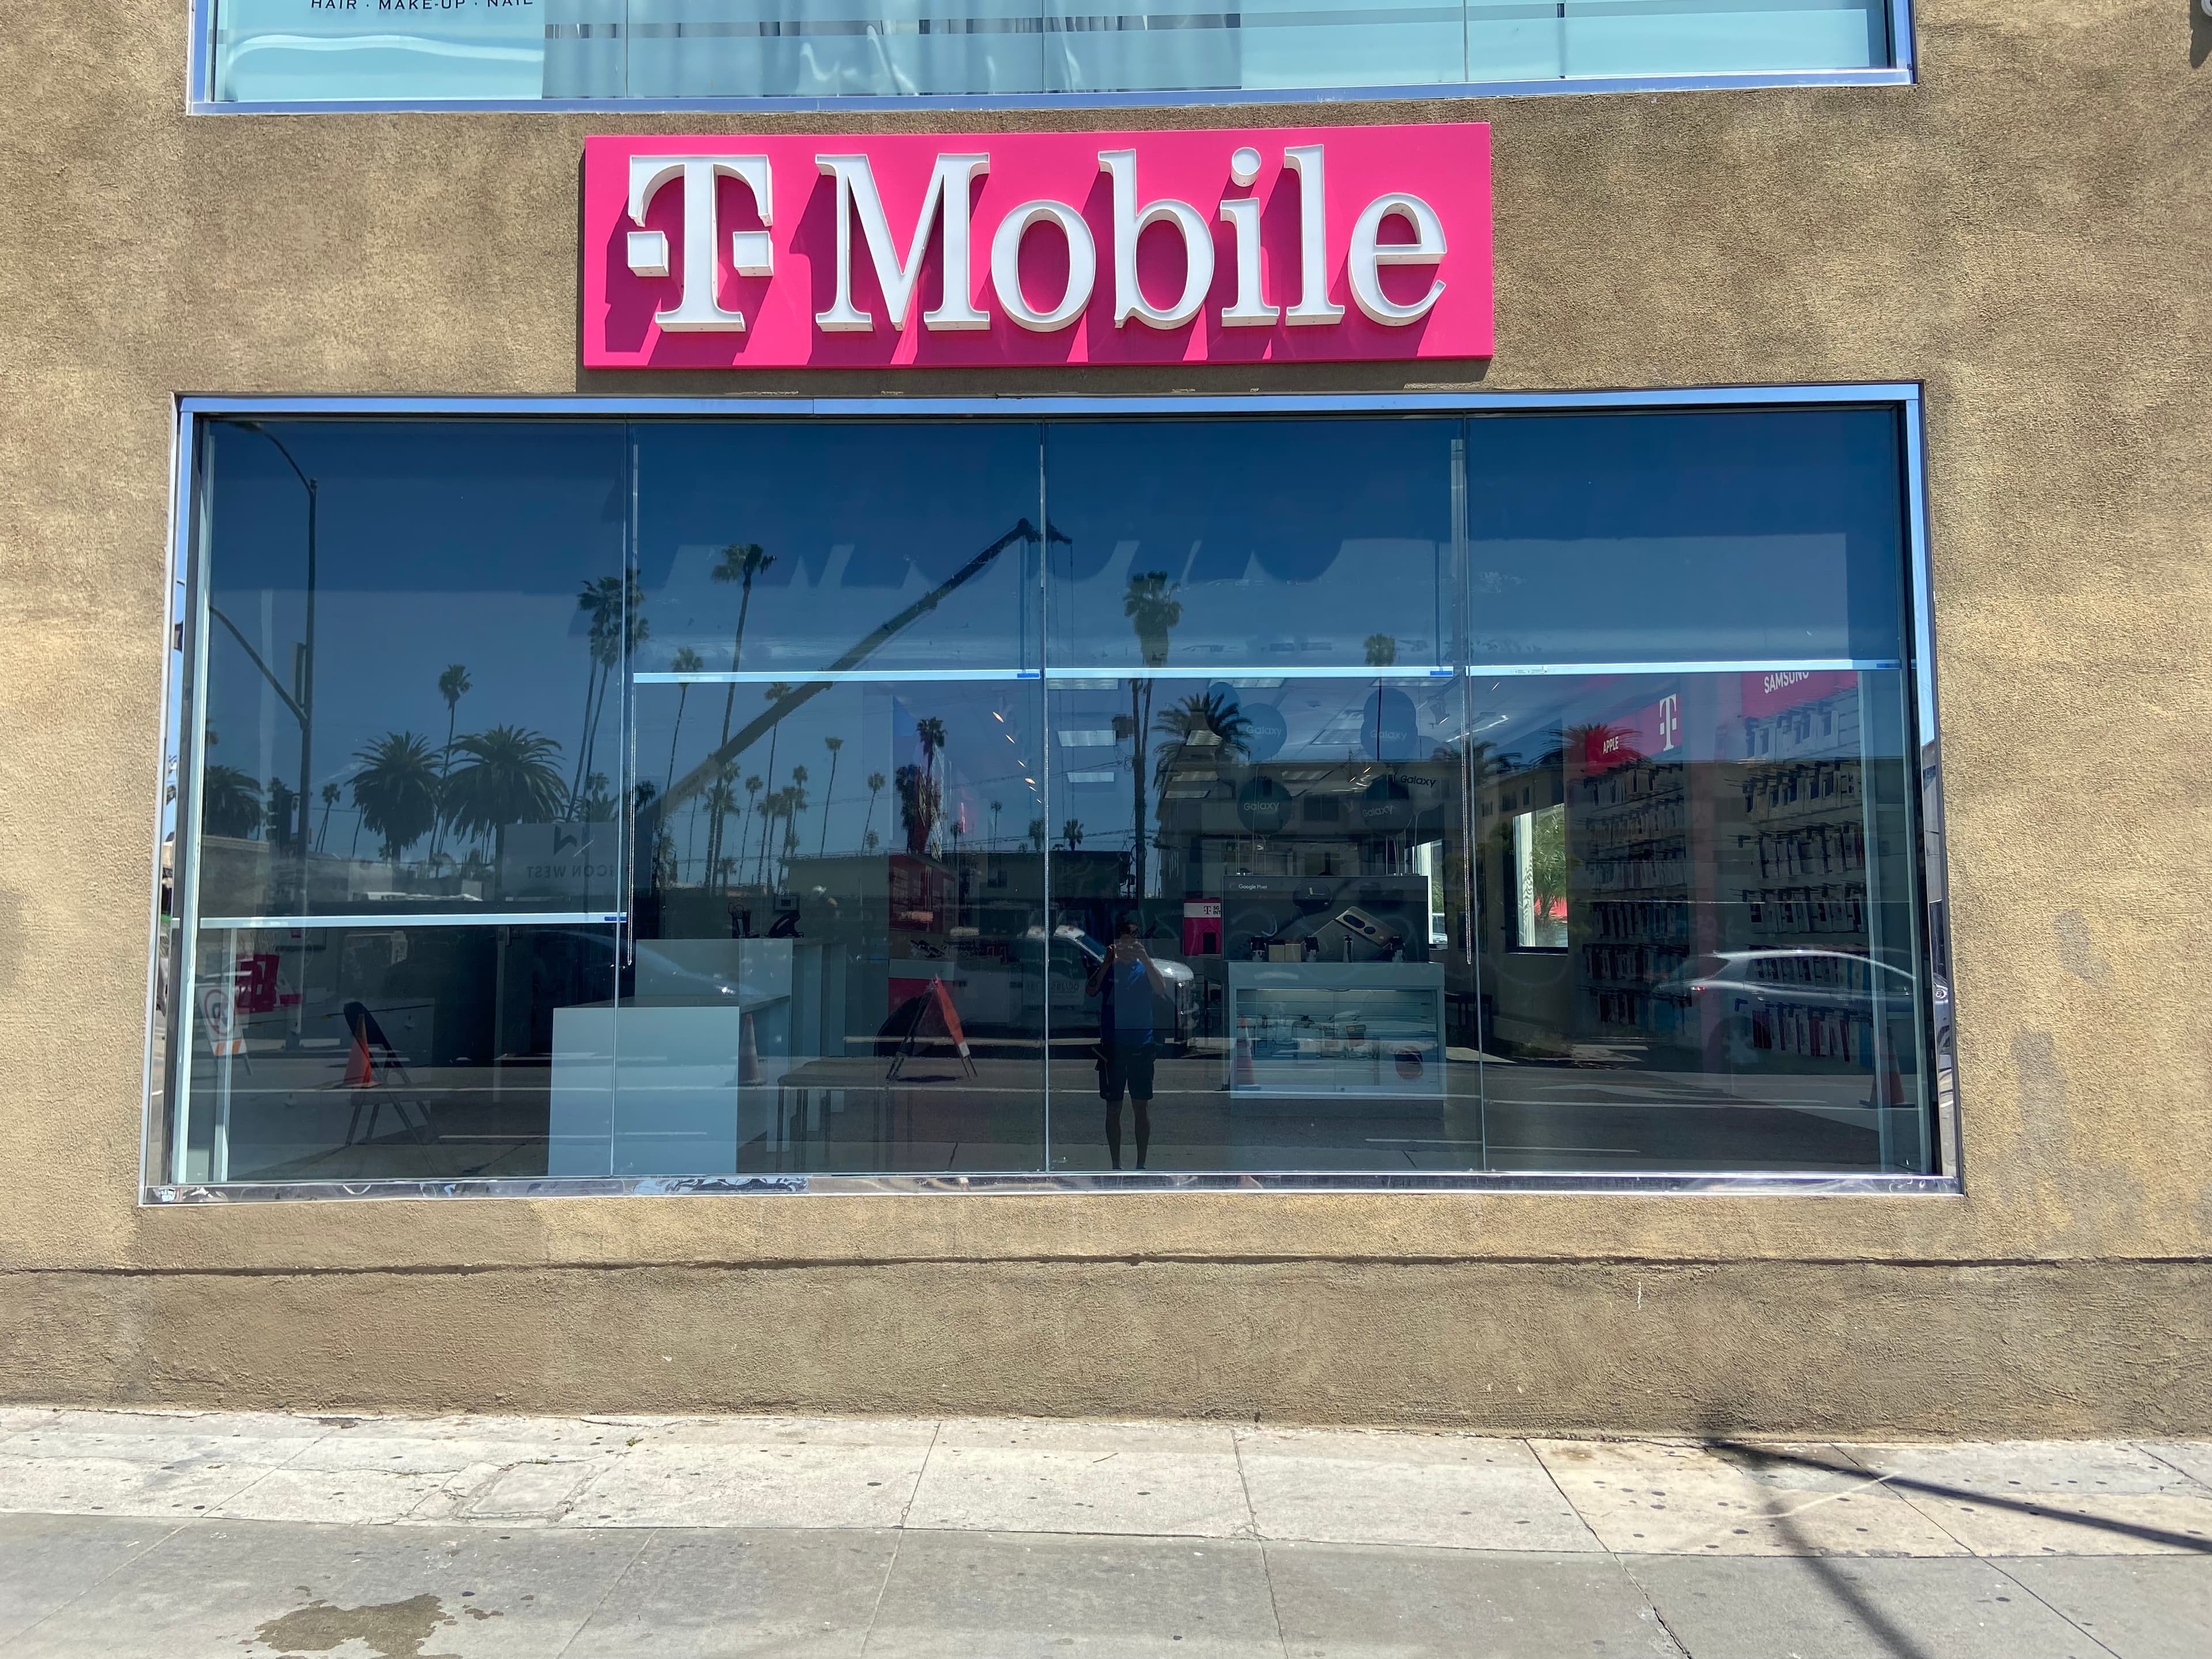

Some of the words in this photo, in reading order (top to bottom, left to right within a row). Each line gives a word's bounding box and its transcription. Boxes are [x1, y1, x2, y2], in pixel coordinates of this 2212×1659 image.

[311, 0, 357, 9] HAIR
[378, 0, 465, 10] MAKE-UP
[813, 145, 1449, 332] Mobile
[1246, 725, 1282, 736] Galaxy
[1370, 729, 1408, 741] Galaxy
[1603, 736, 1619, 755] APPLE
[1400, 775, 1436, 788] Galaxy
[1244, 801, 1280, 812] Galaxy
[1362, 804, 1393, 817] Galaxy
